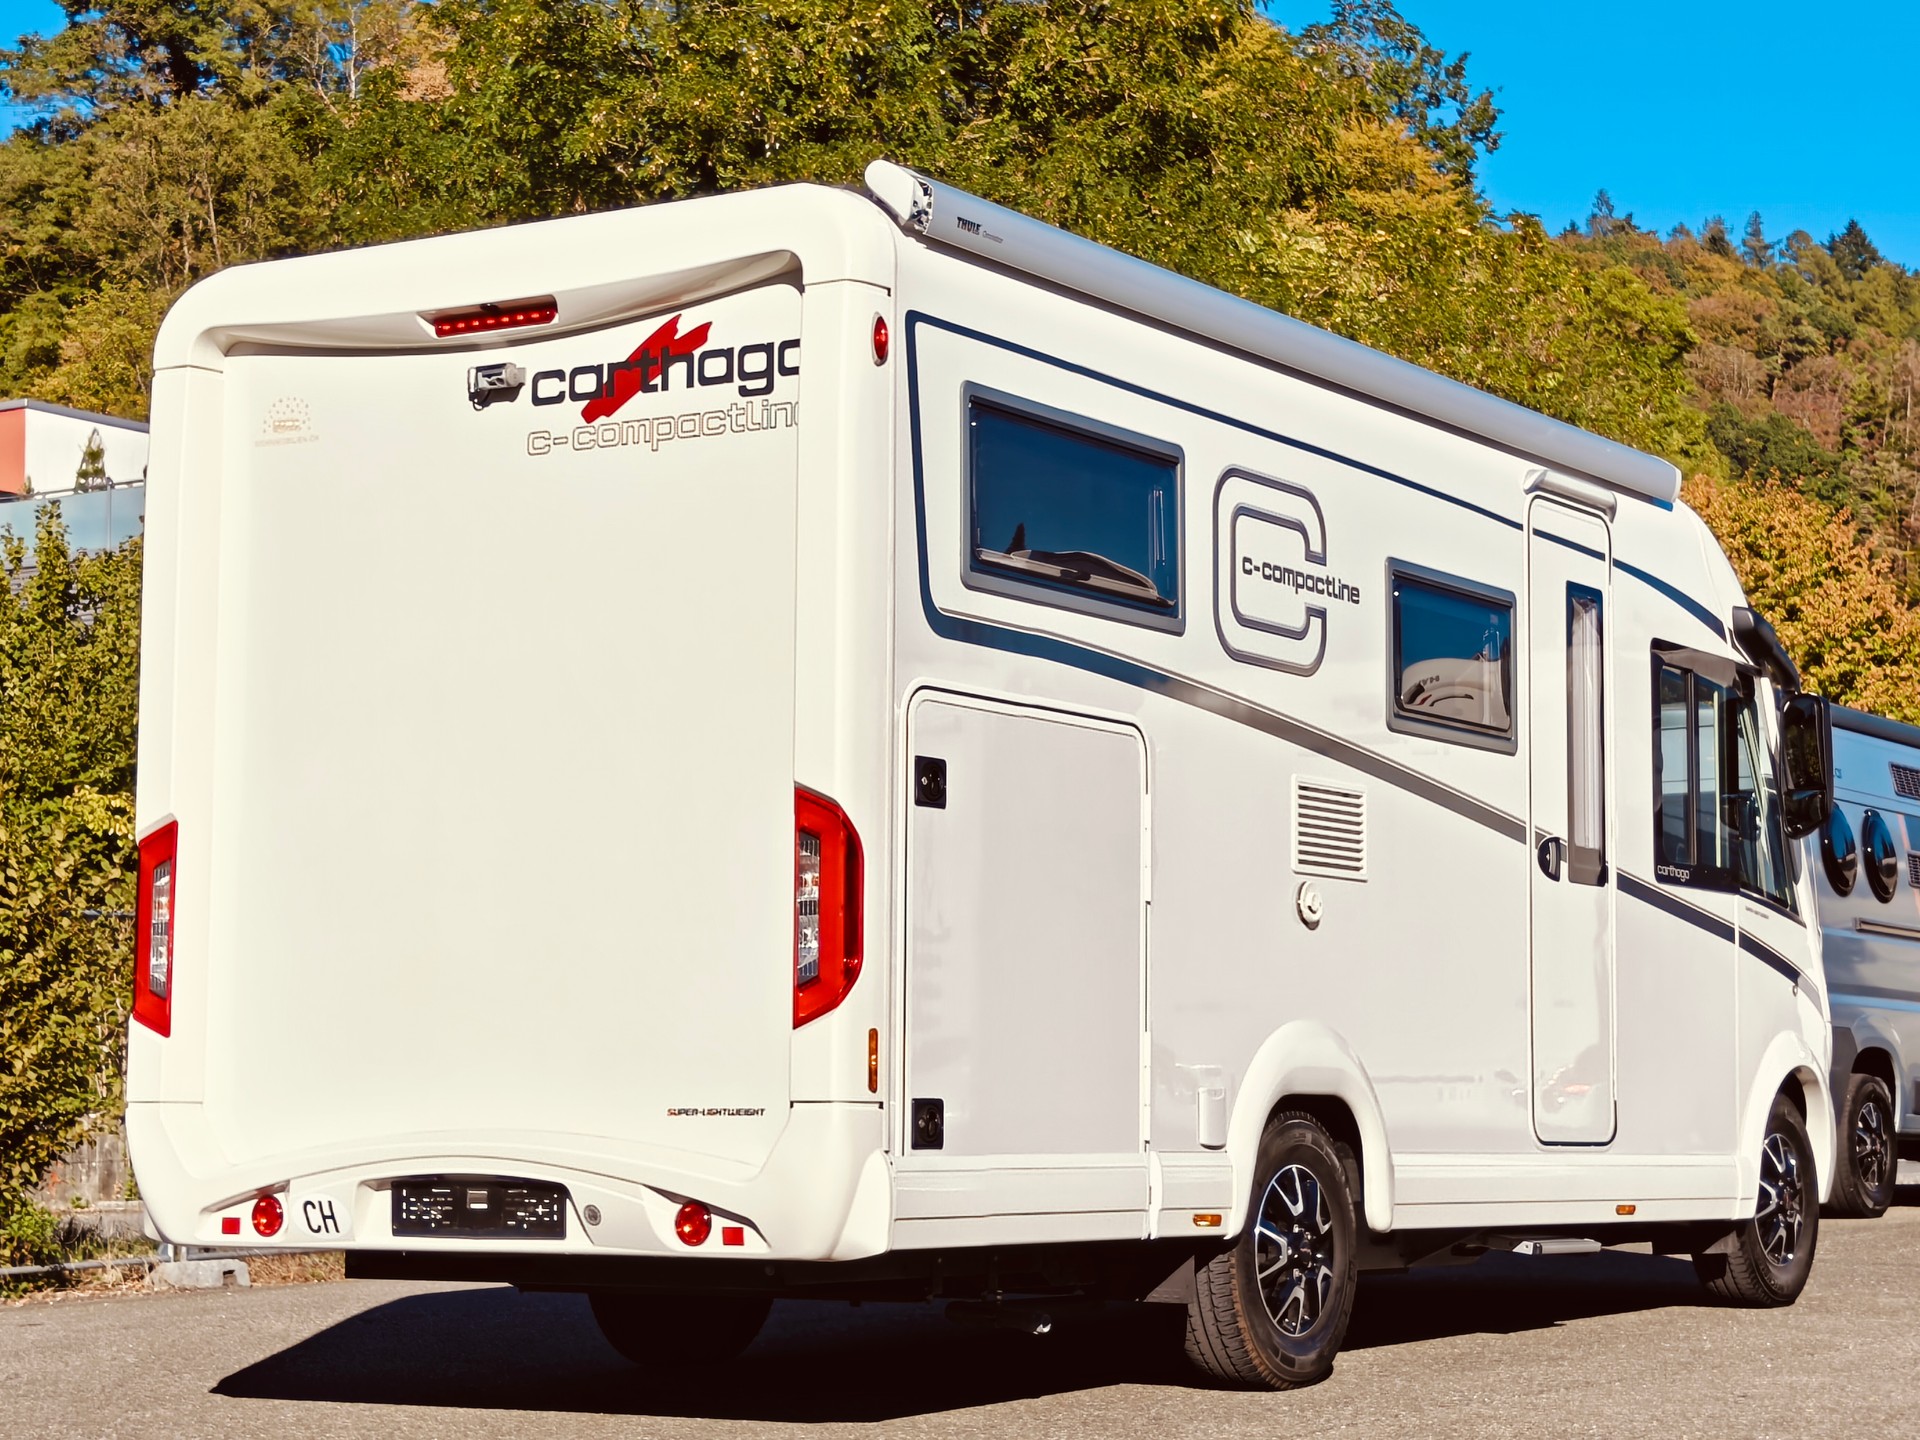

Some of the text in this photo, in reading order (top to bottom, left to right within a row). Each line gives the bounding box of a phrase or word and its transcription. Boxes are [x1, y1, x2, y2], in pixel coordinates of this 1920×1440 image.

[957, 216, 982, 236] THULE
[527, 399, 799, 456] c-compactlin
[1242, 556, 1360, 605] c-compactline
[1657, 864, 1690, 882] carthago
[303, 1200, 340, 1234] CH
